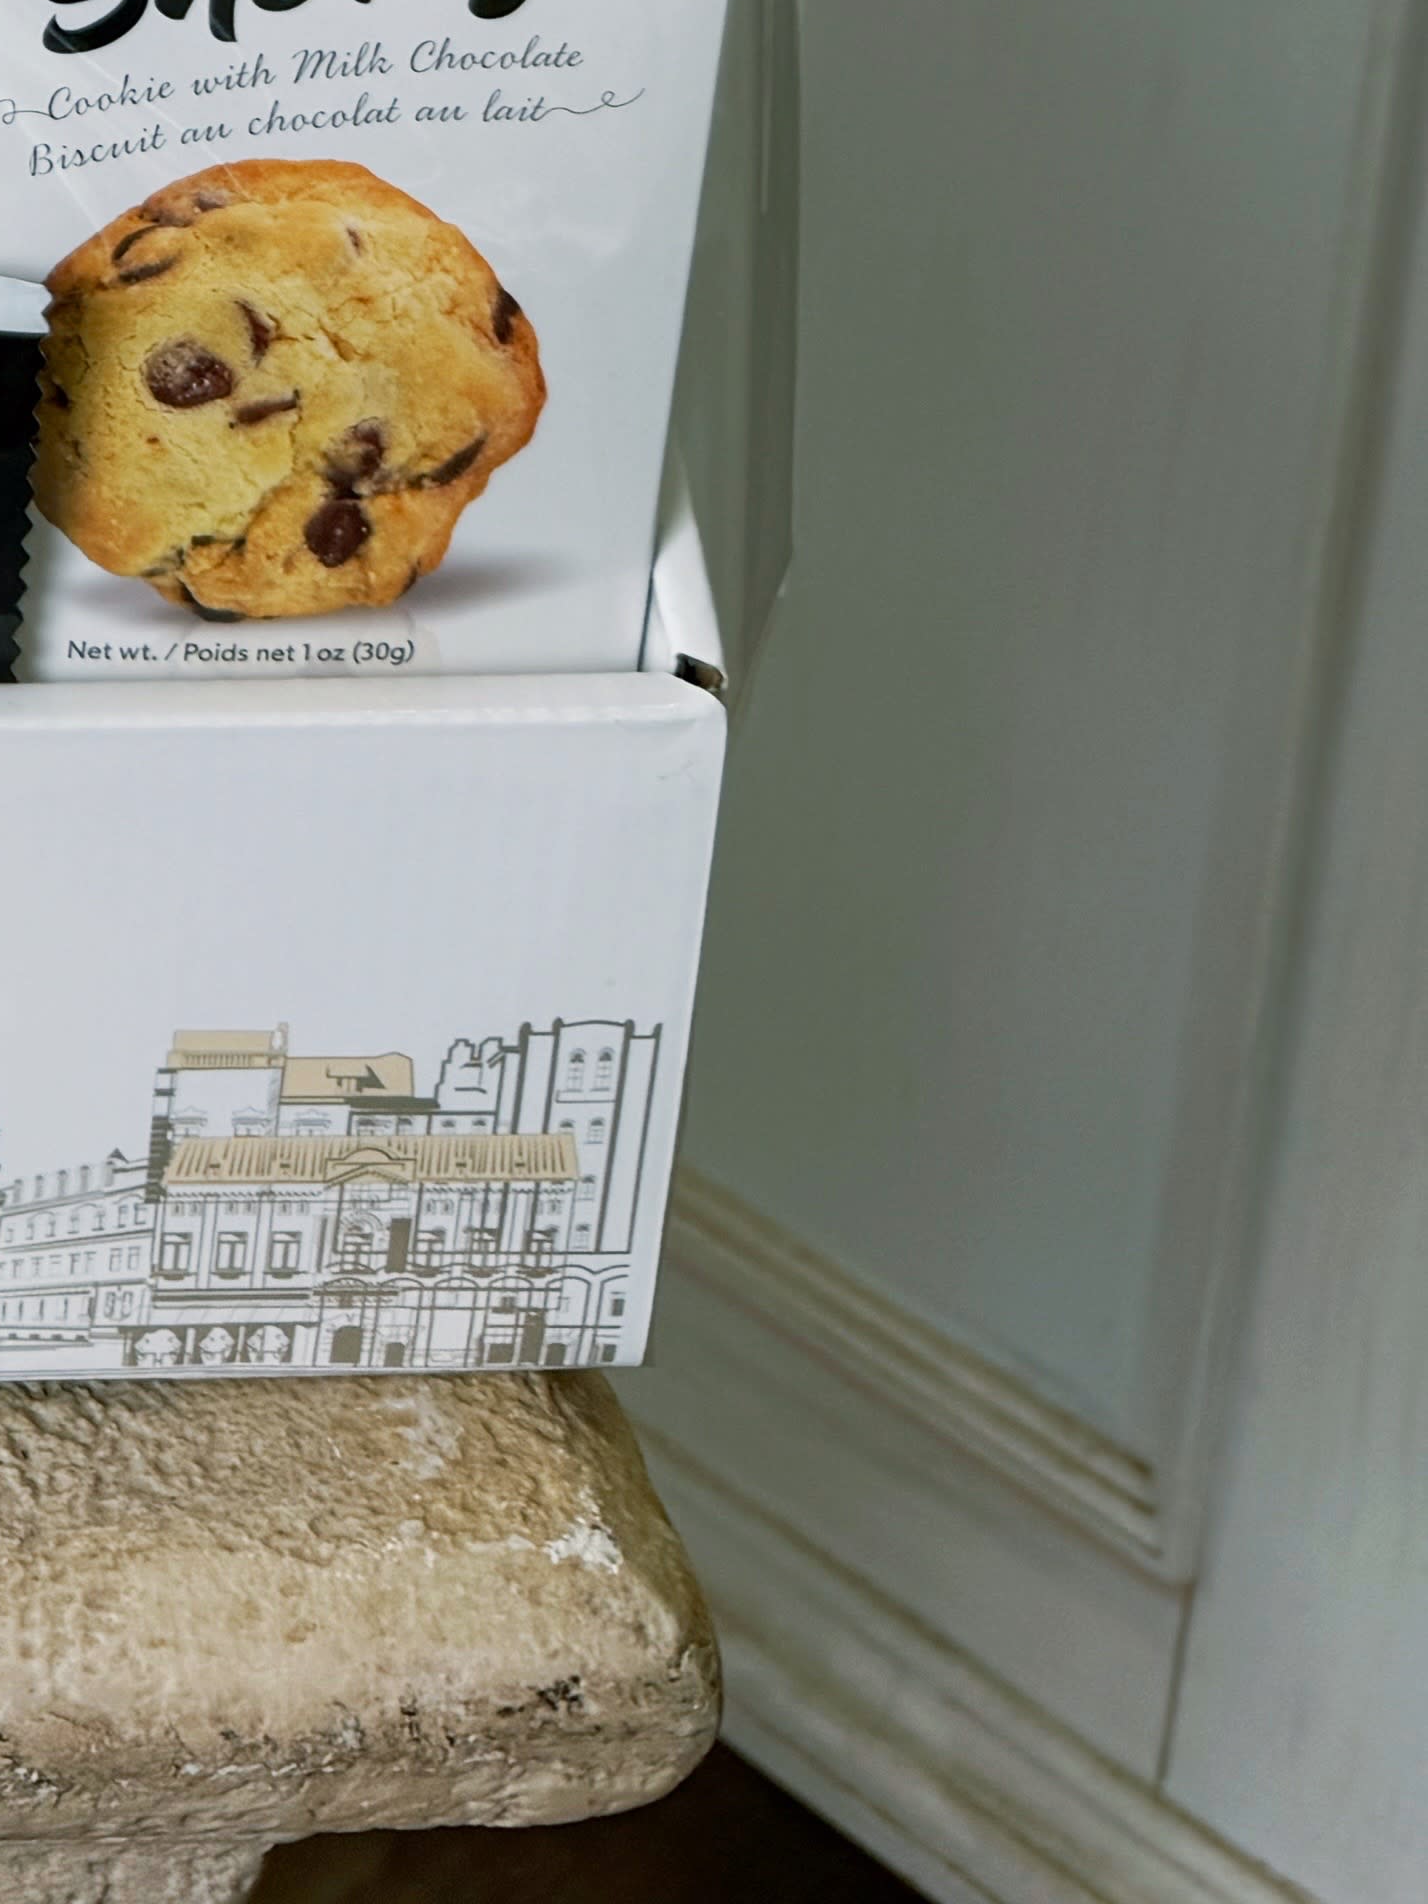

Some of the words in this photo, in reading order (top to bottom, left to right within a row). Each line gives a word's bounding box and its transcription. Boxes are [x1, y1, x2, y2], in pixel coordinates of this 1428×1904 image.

[44, 75, 175, 121] Cookie
[193, 55, 276, 96] with
[291, 39, 396, 84] Milk
[410, 34, 584, 75] Chocolate
[29, 125, 169, 177] Biscuit
[180, 122, 232, 147] au
[248, 94, 403, 138] chocolat
[415, 100, 467, 126] au
[482, 88, 550, 126] lait
[67, 640, 113, 662] Net
[119, 644, 158, 663] wt.
[182, 640, 249, 664] Poids
[255, 644, 296, 664] net
[352, 639, 415, 665] (30g)
